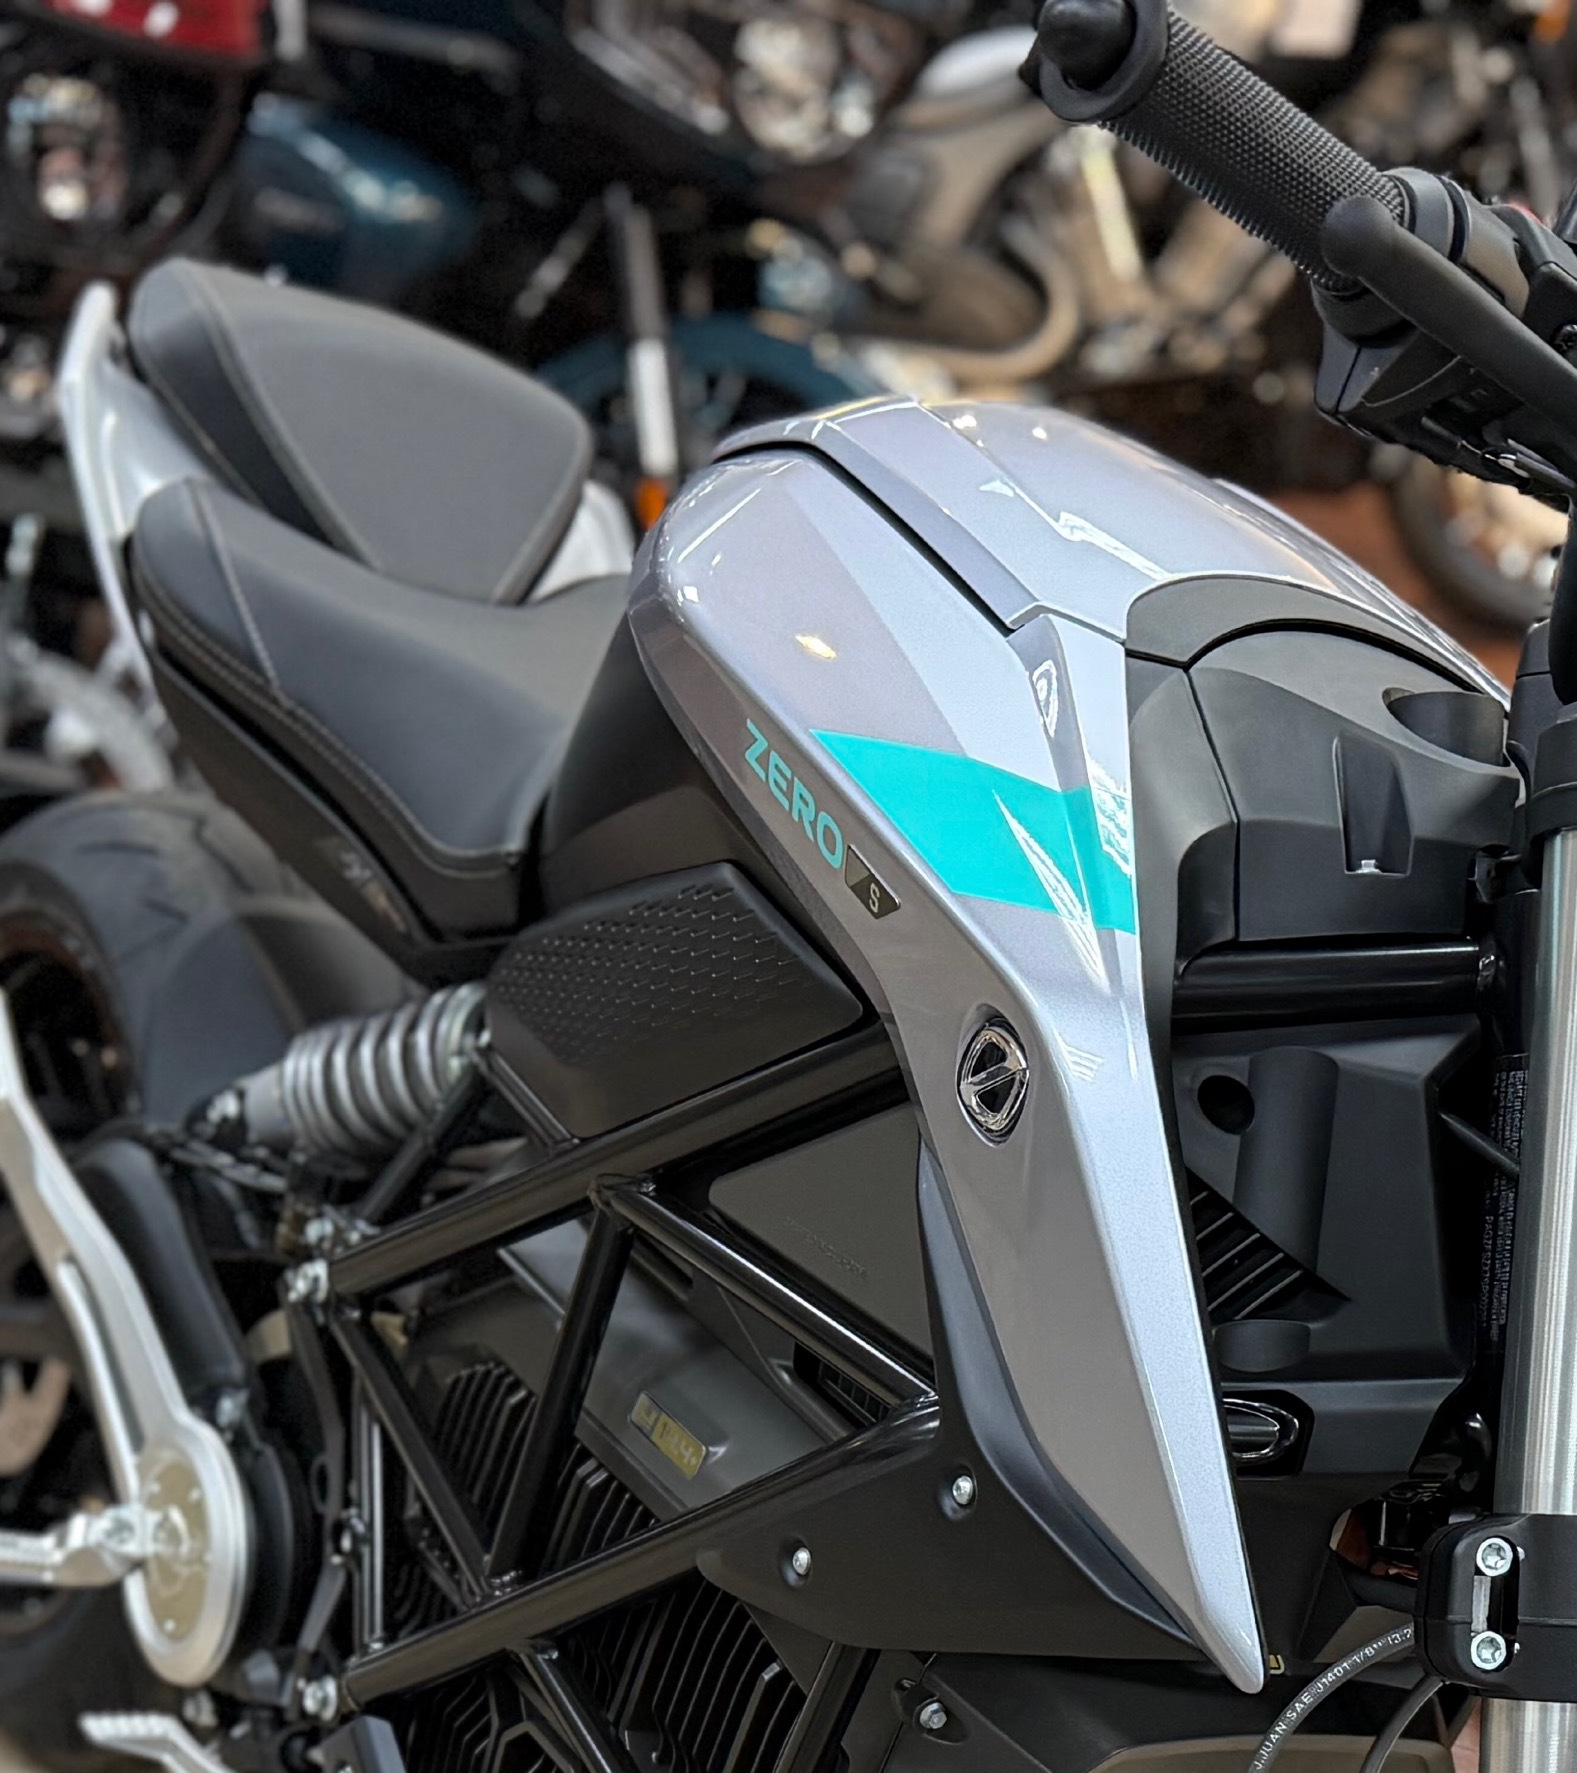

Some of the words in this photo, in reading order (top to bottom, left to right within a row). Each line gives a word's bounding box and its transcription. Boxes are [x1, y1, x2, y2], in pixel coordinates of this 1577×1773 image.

[744, 717, 844, 869] ZERO
[868, 882, 880, 913] S
[1286, 1691, 1314, 1721] SAE
[1315, 1662, 1351, 1693] J1401
